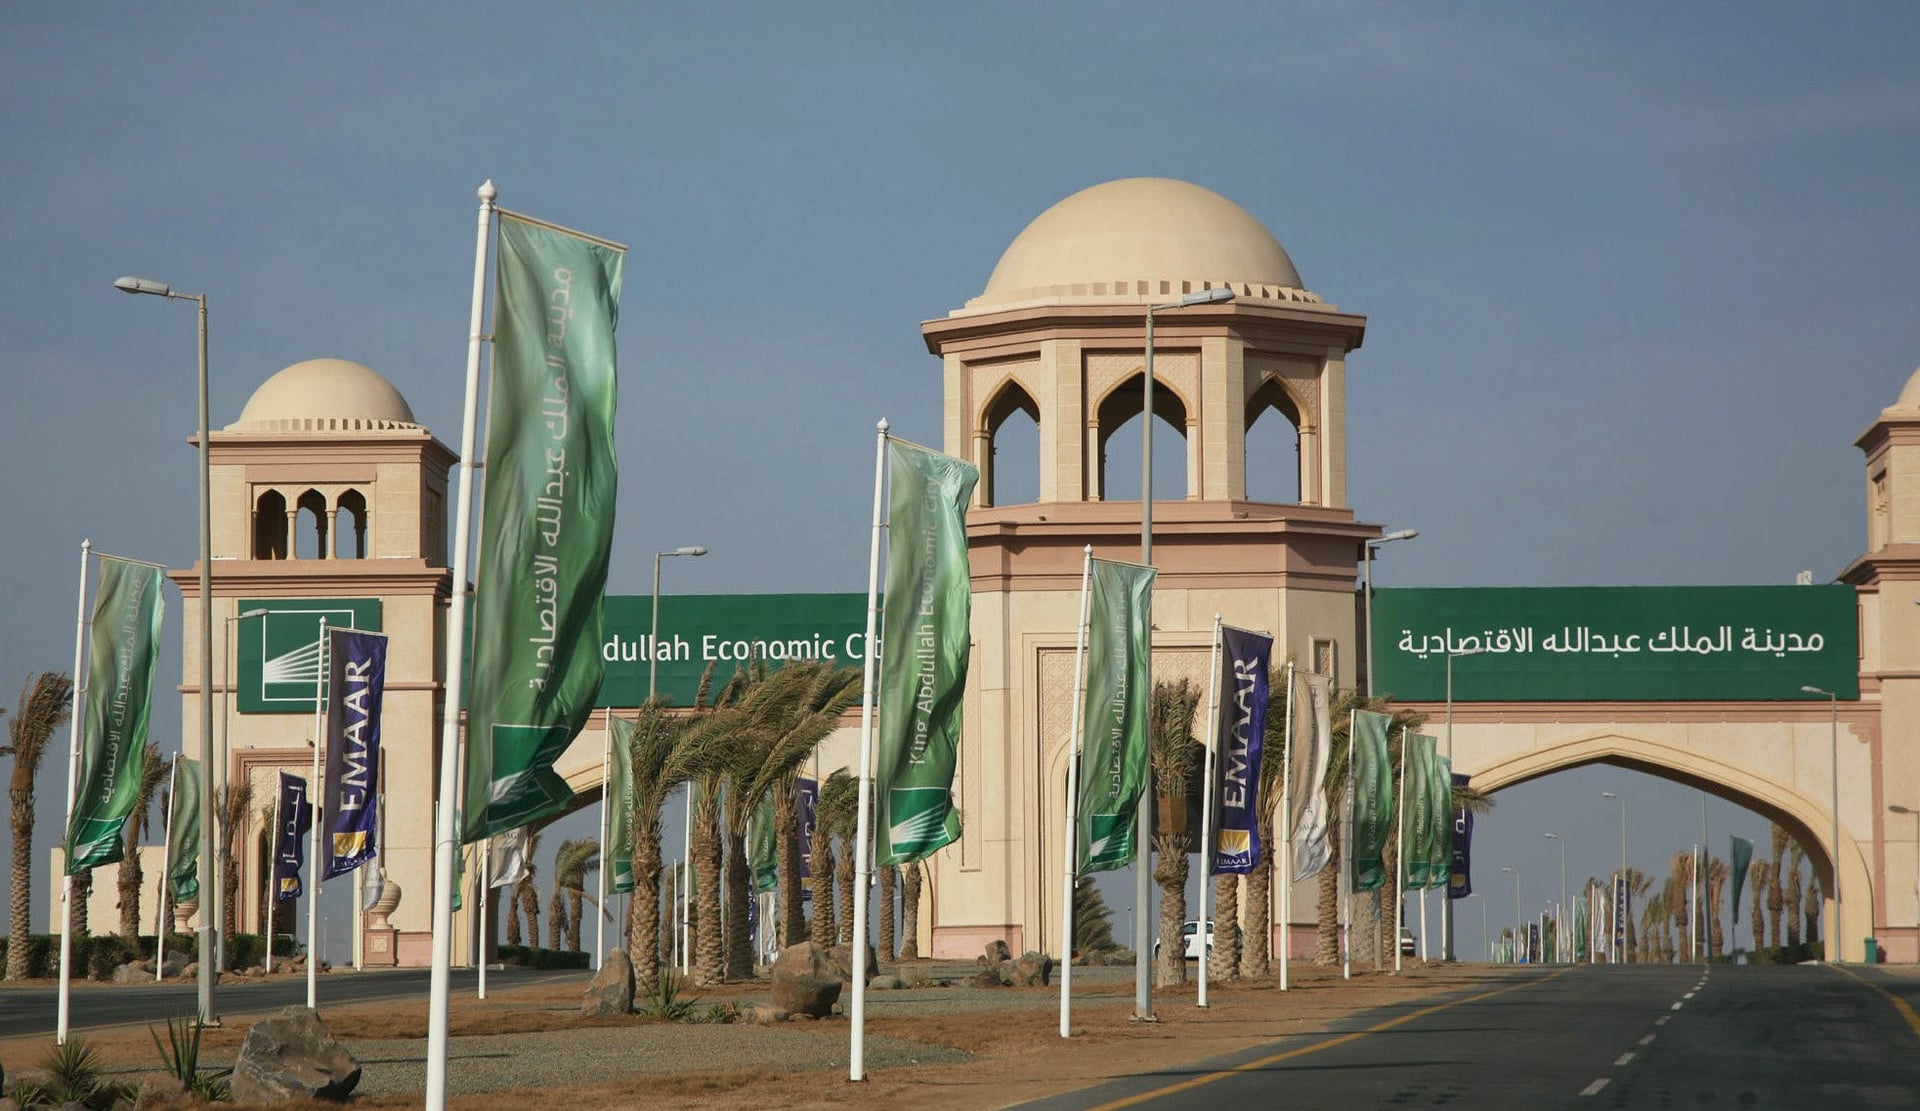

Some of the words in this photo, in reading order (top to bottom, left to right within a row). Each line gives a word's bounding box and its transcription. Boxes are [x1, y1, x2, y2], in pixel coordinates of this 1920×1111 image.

[548, 267, 574, 347] مدينة
[542, 354, 569, 440] الملك
[537, 447, 570, 547] عبدالله
[925, 477, 941, 513] City
[918, 521, 938, 616] Economic
[528, 554, 558, 693] الاقتصادية
[603, 634, 690, 661] dullah
[702, 633, 836, 661] Economic
[846, 633, 882, 659] Ct
[1398, 627, 1533, 659] الاقتصادية
[1542, 626, 1641, 658] عبدالله
[1648, 626, 1732, 654] الملك
[1741, 627, 1824, 657] مدينة
[916, 624, 935, 714] Abdullah
[340, 657, 372, 812] EMAAR
[909, 720, 927, 764] King
[1223, 657, 1258, 810] EMAAR
